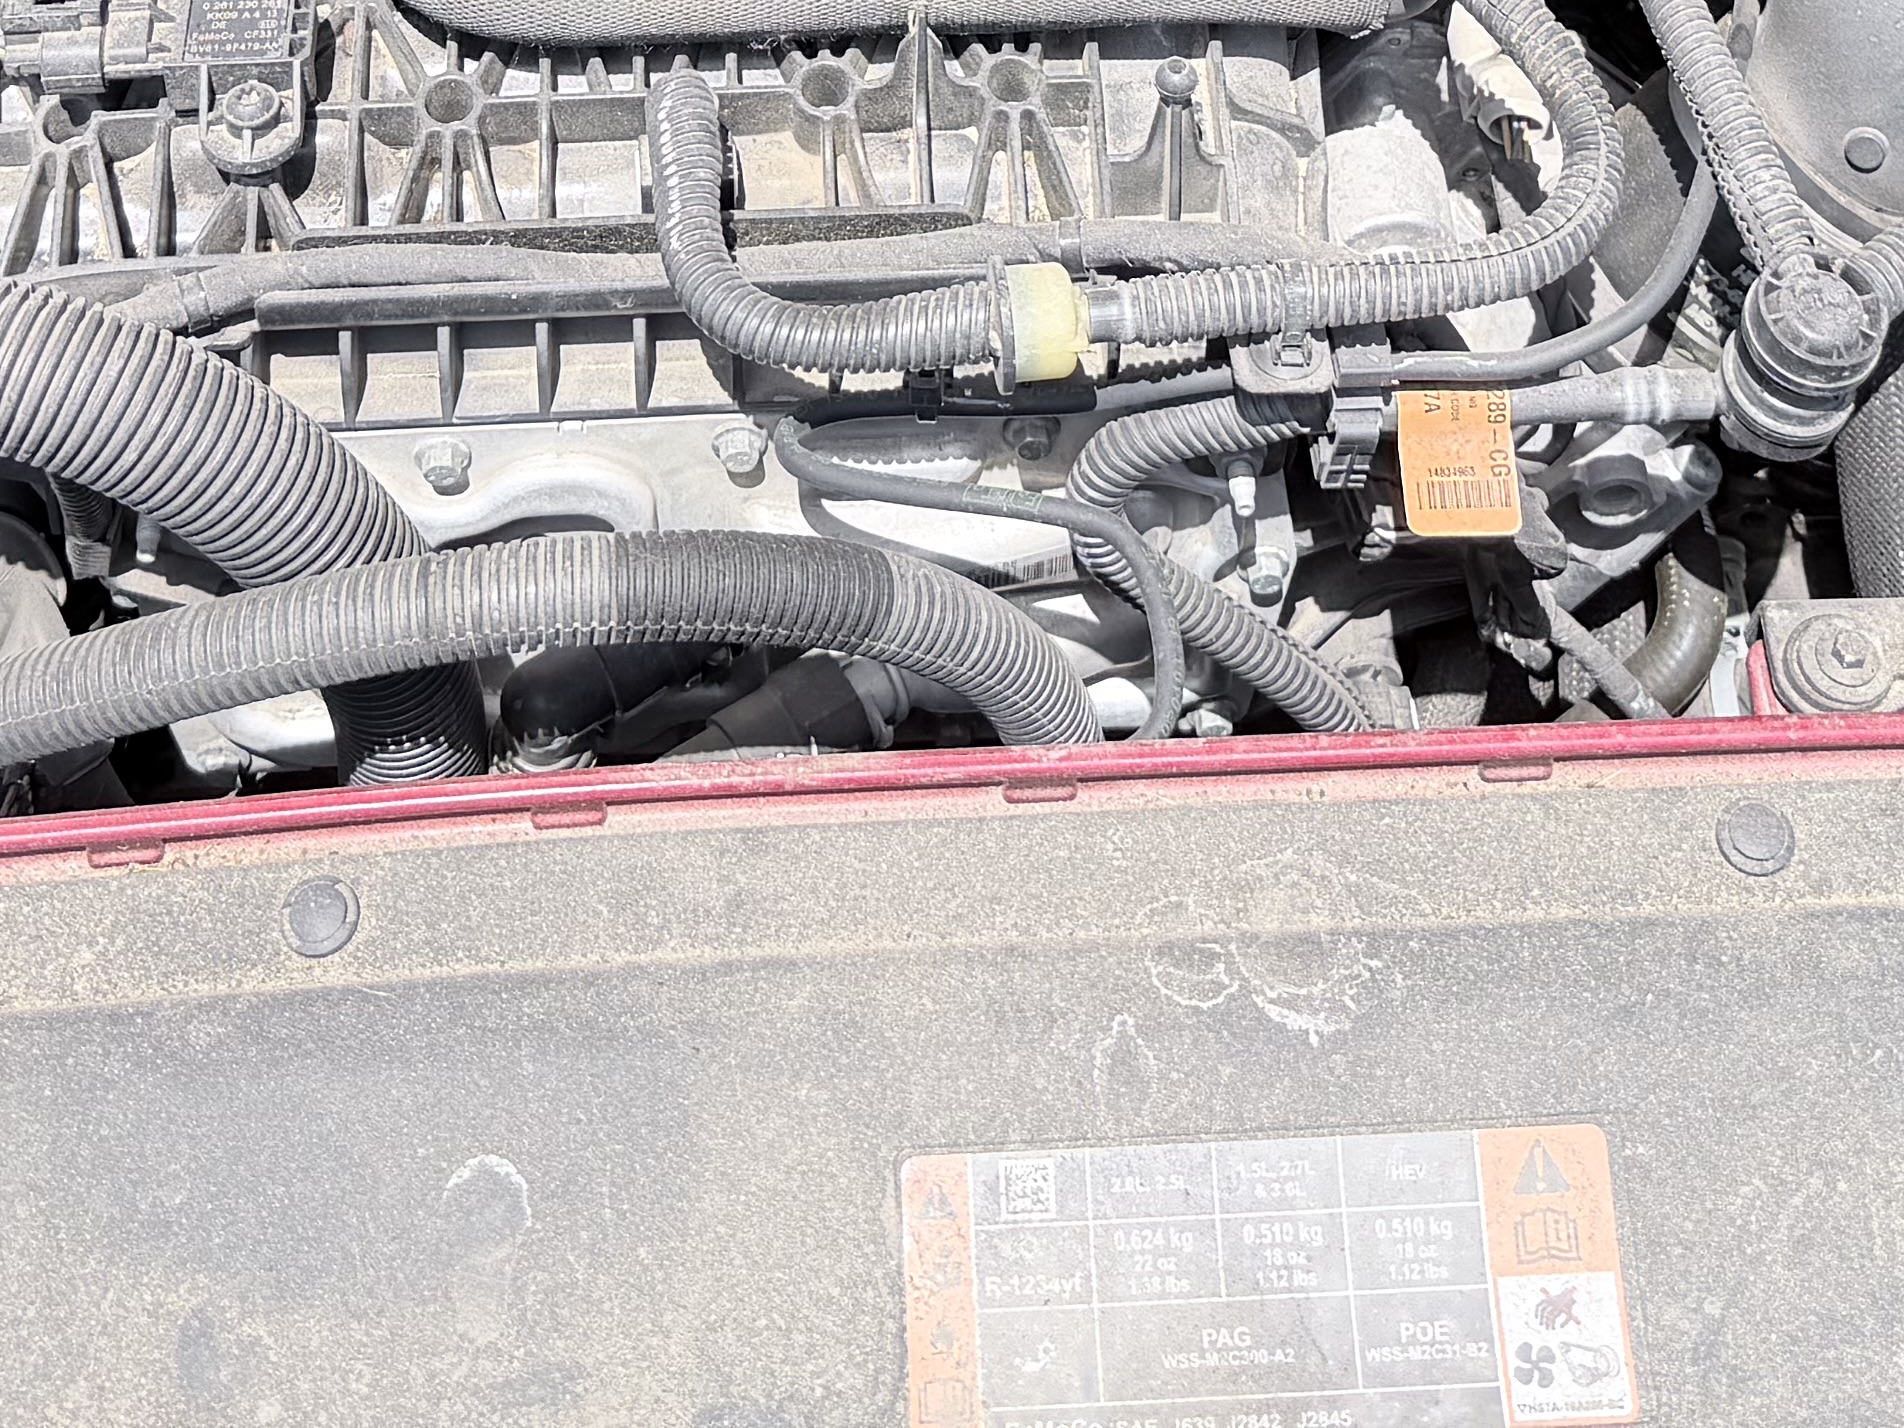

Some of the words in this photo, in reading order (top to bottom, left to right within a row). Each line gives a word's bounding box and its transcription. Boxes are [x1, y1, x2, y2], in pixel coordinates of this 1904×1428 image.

[1242, 1223, 1294, 1244] 0.510
[1299, 1221, 1323, 1246] kg
[1375, 1217, 1425, 1239] 0.510
[1429, 1216, 1453, 1240] kg
[1113, 1228, 1166, 1251] 0.624
[1170, 1227, 1194, 1252] kg
[1264, 1249, 1283, 1266] 18
[1287, 1250, 1308, 1265] oz
[1396, 1244, 1414, 1259] 18
[1419, 1244, 1439, 1258] oz
[1135, 1255, 1153, 1271] 22
[1156, 1256, 1177, 1270] oz
[1388, 1264, 1420, 1281] 1.12
[1424, 1262, 1449, 1279] lbs
[984, 1271, 1084, 1298] R-1234yf
[1165, 1276, 1191, 1293] lbs
[1256, 1270, 1288, 1288] 1.12
[1293, 1269, 1318, 1286] lbs
[1201, 1326, 1253, 1348] PAG
[1399, 1319, 1450, 1343] POE
[1296, 1410, 1353, 1428] J2845
